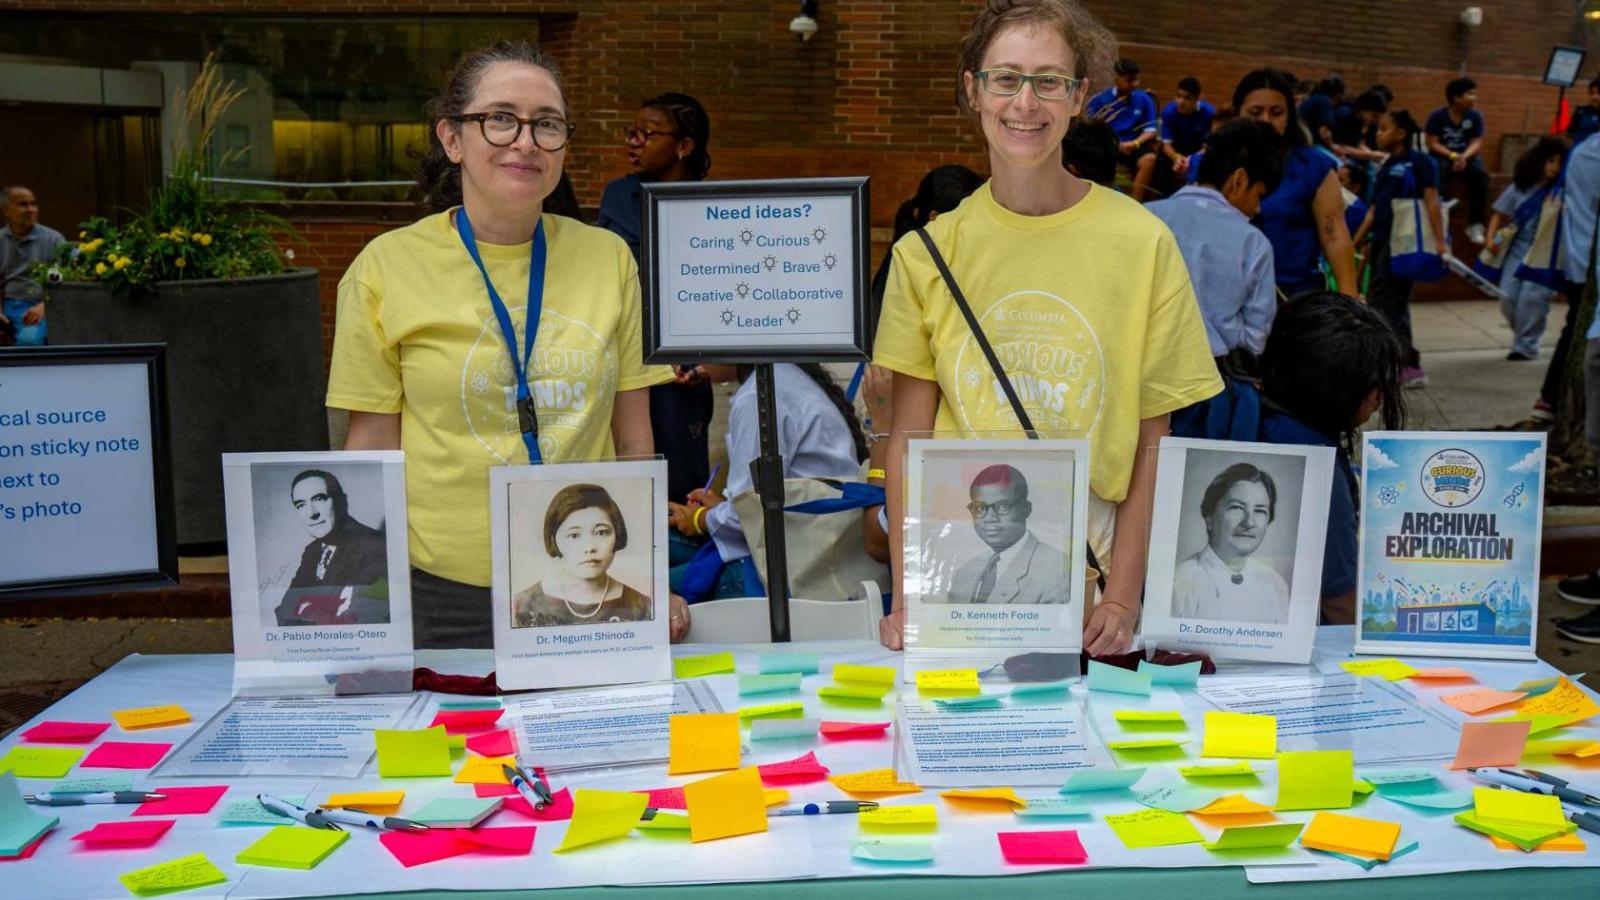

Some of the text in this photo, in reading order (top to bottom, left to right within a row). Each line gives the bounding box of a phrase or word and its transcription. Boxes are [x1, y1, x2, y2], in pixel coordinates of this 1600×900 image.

[706, 204, 812, 220] Need ideas?
[689, 235, 810, 251] Caring Curious
[680, 261, 821, 276] Determined Brave
[677, 287, 844, 302] Creative Collaborative
[737, 315, 784, 327] Leader
[37, 409, 106, 425] source
[30, 439, 90, 458] sticky
[95, 437, 140, 453] note
[40, 472, 60, 487] to
[1430, 465, 1477, 479] CURIOUS
[22, 501, 82, 522] photo
[1400, 512, 1500, 537] ARCHIVAL
[1385, 535, 1513, 561] EXPLORATION
[951, 611, 1039, 620] Dr. Kenneth Forde
[266, 630, 386, 642] Dr. Pablo Morales-Otero
[537, 631, 634, 644] Dr. Megumi Shinoda
[1179, 624, 1282, 638] Dr. Dorothy Andersen
